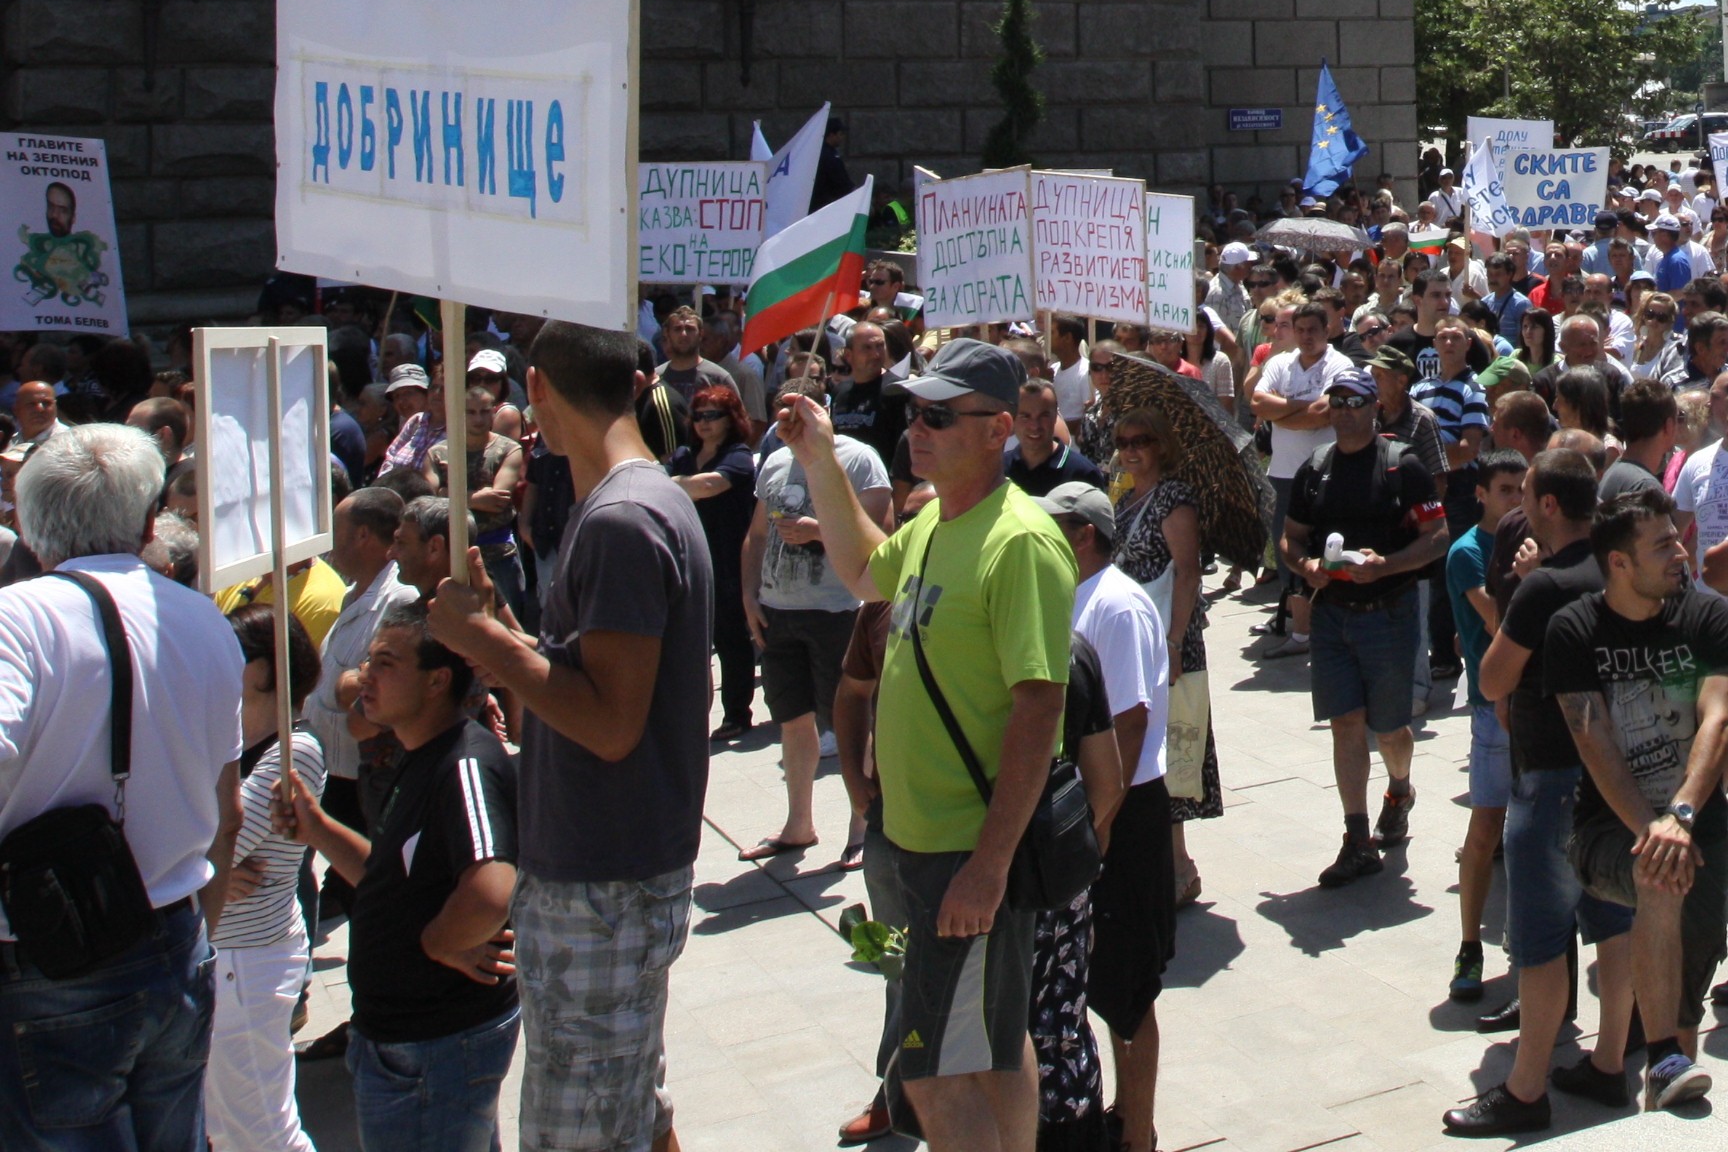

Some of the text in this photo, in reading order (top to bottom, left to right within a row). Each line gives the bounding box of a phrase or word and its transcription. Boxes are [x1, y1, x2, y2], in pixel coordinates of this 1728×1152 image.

[7, 151, 99, 167] НА ЗЕЛЕНИЯ
[18, 138, 83, 152] ГЛАВИТЕ
[21, 165, 91, 181] ОКТОПОД
[1514, 152, 1597, 176] СКИТЕ
[640, 168, 760, 200] ДУПНИЦА
[1537, 179, 1570, 201] СА
[699, 199, 765, 232] СТОП
[922, 191, 1027, 235] ПЛАНИНАТА
[1033, 179, 1142, 224] ДУПНИЦА
[690, 233, 708, 248] НА
[1036, 219, 1135, 252] ПОДКРЕПЯ
[931, 227, 1024, 278] ДОСТЪПНА
[1041, 251, 1145, 282] РАЗВИТИЕТО
[926, 273, 1029, 315] ЗА ХОРАТА
[1036, 280, 1146, 313] НА ТУРИЗМА
[35, 315, 109, 328] ТОМА БЕЛЕВ
